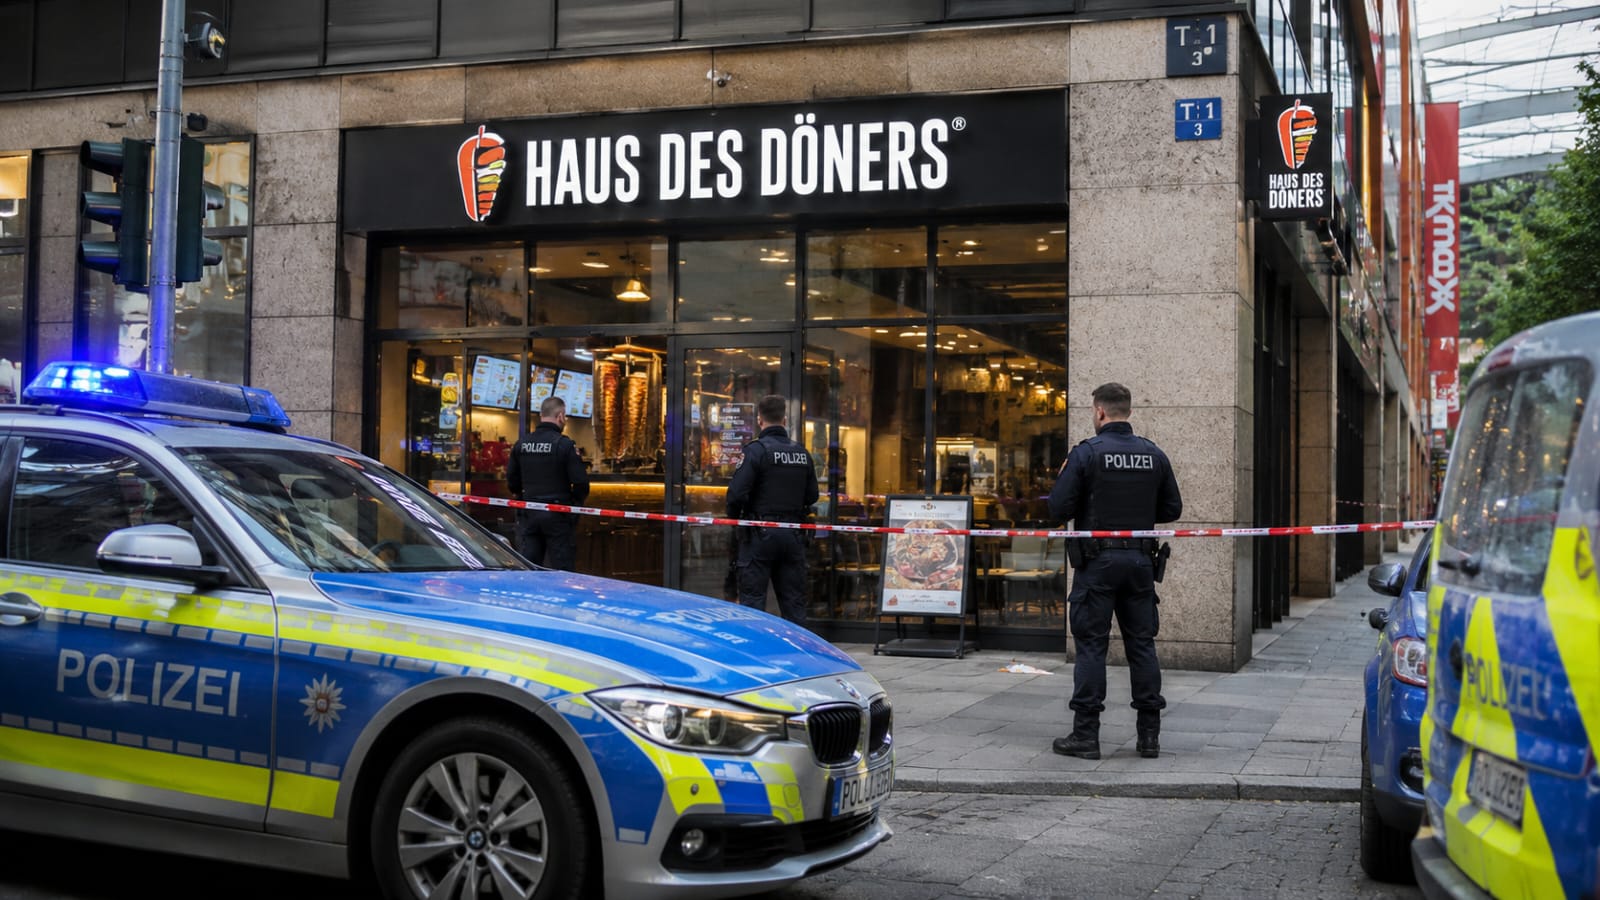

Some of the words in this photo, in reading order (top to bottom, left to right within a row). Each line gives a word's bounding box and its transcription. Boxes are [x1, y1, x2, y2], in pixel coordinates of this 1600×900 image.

[1174, 25, 1191, 46] T
[1206, 24, 1215, 44] 1
[1191, 51, 1203, 66] 3
[1180, 103, 1195, 120] T
[1206, 102, 1214, 119] 1
[1194, 123, 1203, 136] 3
[525, 134, 640, 207] HAUS
[659, 129, 743, 200] DES
[1269, 173, 1299, 190] HAUS
[1302, 173, 1324, 188] DES
[1269, 186, 1324, 209] DÖNERS
[521, 442, 553, 453] POLIZEI
[774, 451, 808, 465] POLIZEI
[1104, 454, 1153, 469] POLIZEI
[56, 648, 242, 717] POLIZEI
